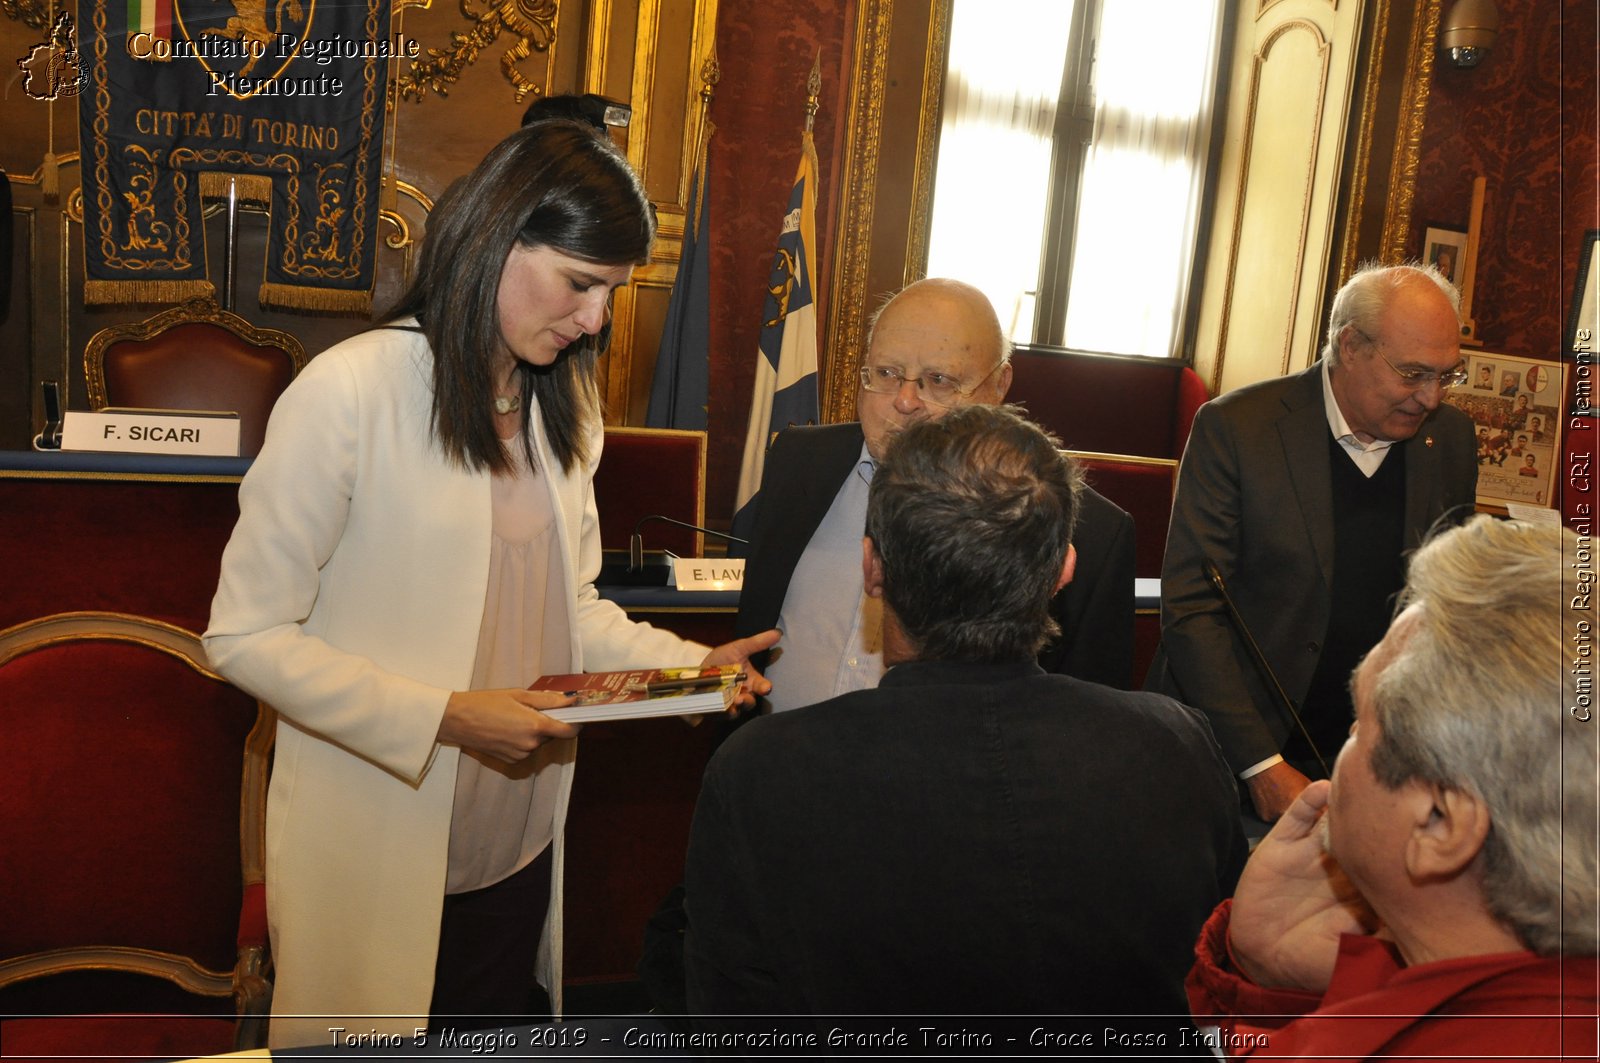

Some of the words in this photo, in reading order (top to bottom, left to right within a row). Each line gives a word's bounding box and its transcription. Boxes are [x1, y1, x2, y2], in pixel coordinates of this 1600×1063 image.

[222, 113, 243, 139] DI
[252, 118, 338, 150] TORINO
[104, 424, 122, 440] F.
[128, 425, 200, 443] SICARI
[693, 568, 708, 582] E.
